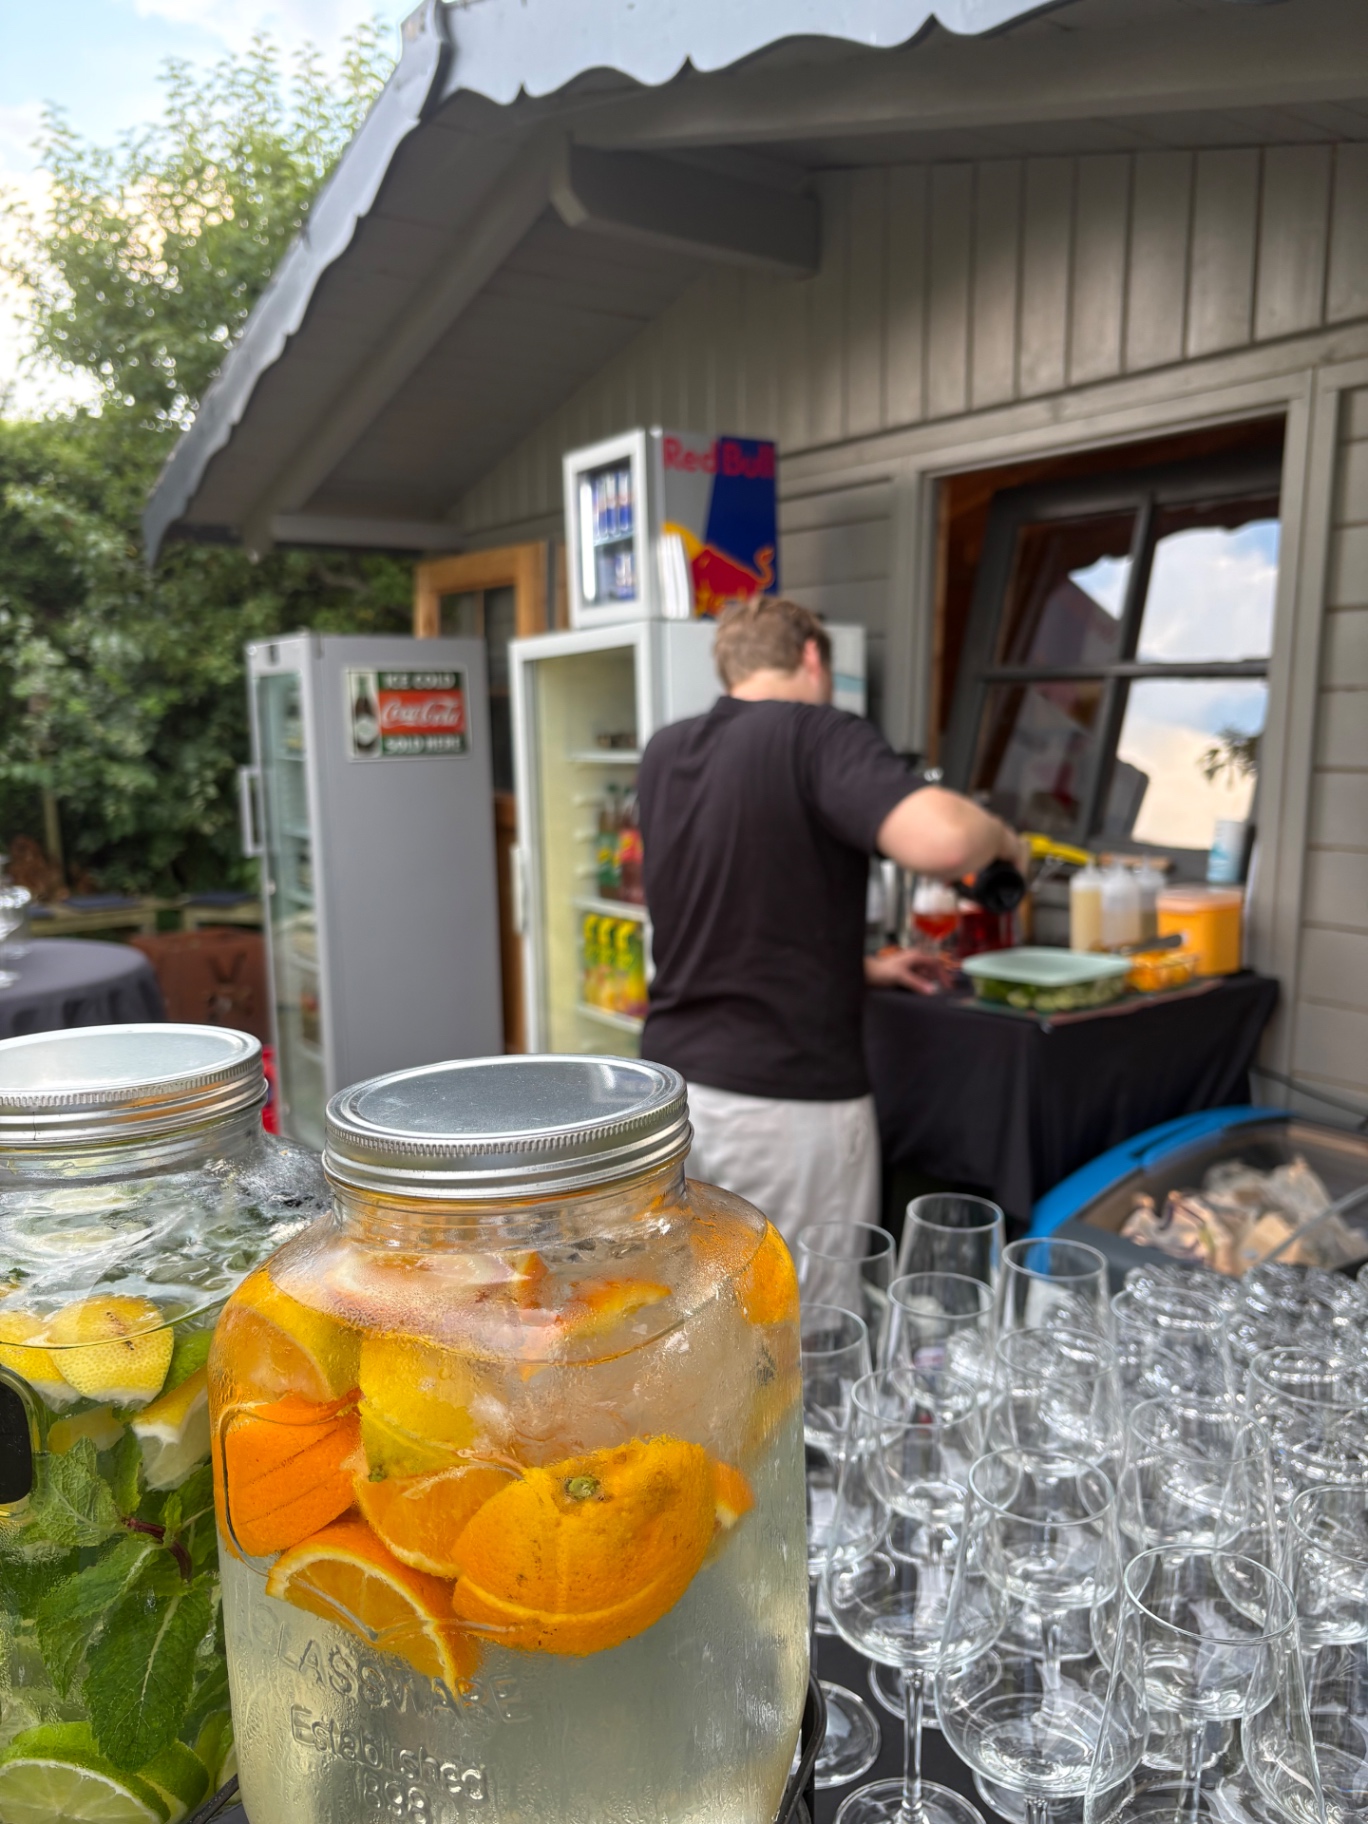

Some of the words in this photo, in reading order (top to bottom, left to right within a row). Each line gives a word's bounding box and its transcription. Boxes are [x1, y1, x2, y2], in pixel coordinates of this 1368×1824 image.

[662, 437, 718, 474] Red
[721, 441, 775, 479] Bull
[384, 673, 409, 690] ICE
[411, 673, 456, 690] COLD
